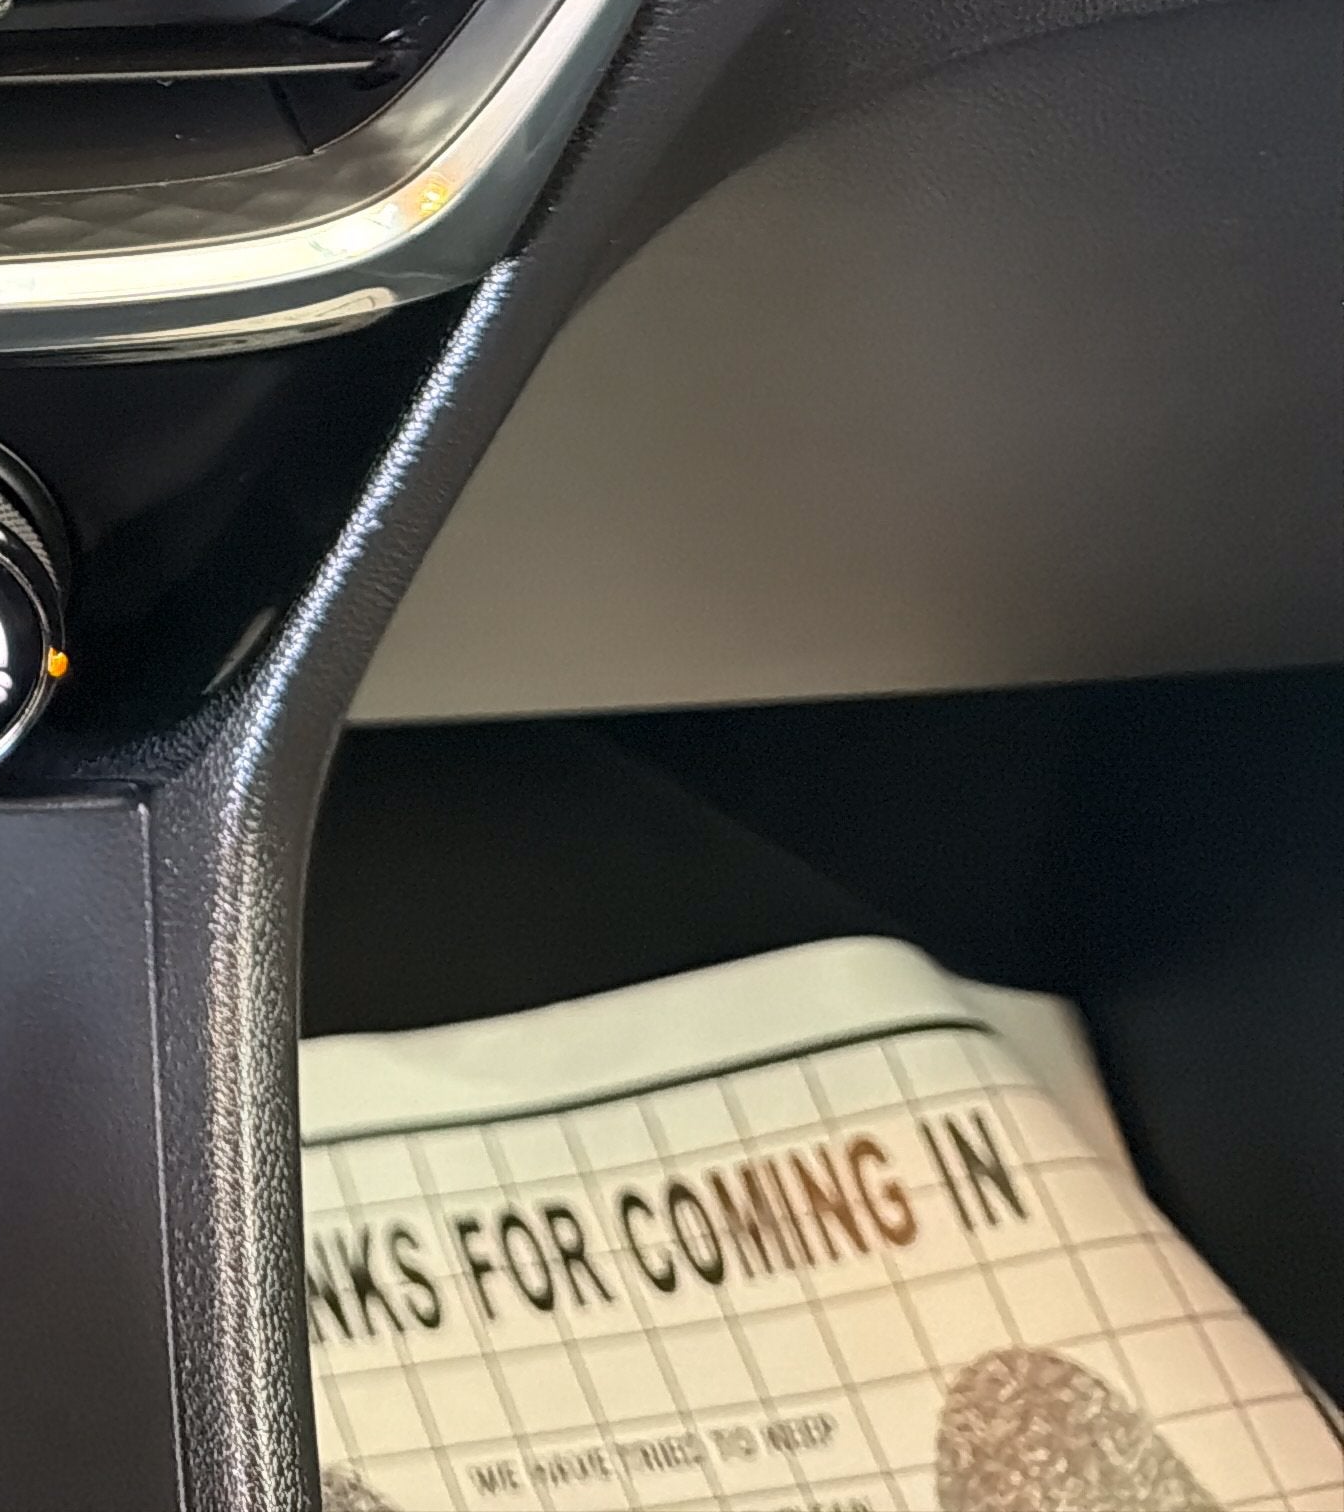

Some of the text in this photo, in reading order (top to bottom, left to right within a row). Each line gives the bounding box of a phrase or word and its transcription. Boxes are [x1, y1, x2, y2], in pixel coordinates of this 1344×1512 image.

[456, 1197, 615, 1321] FOR
[618, 1132, 920, 1293] COMING
[918, 1106, 1029, 1233] IN
